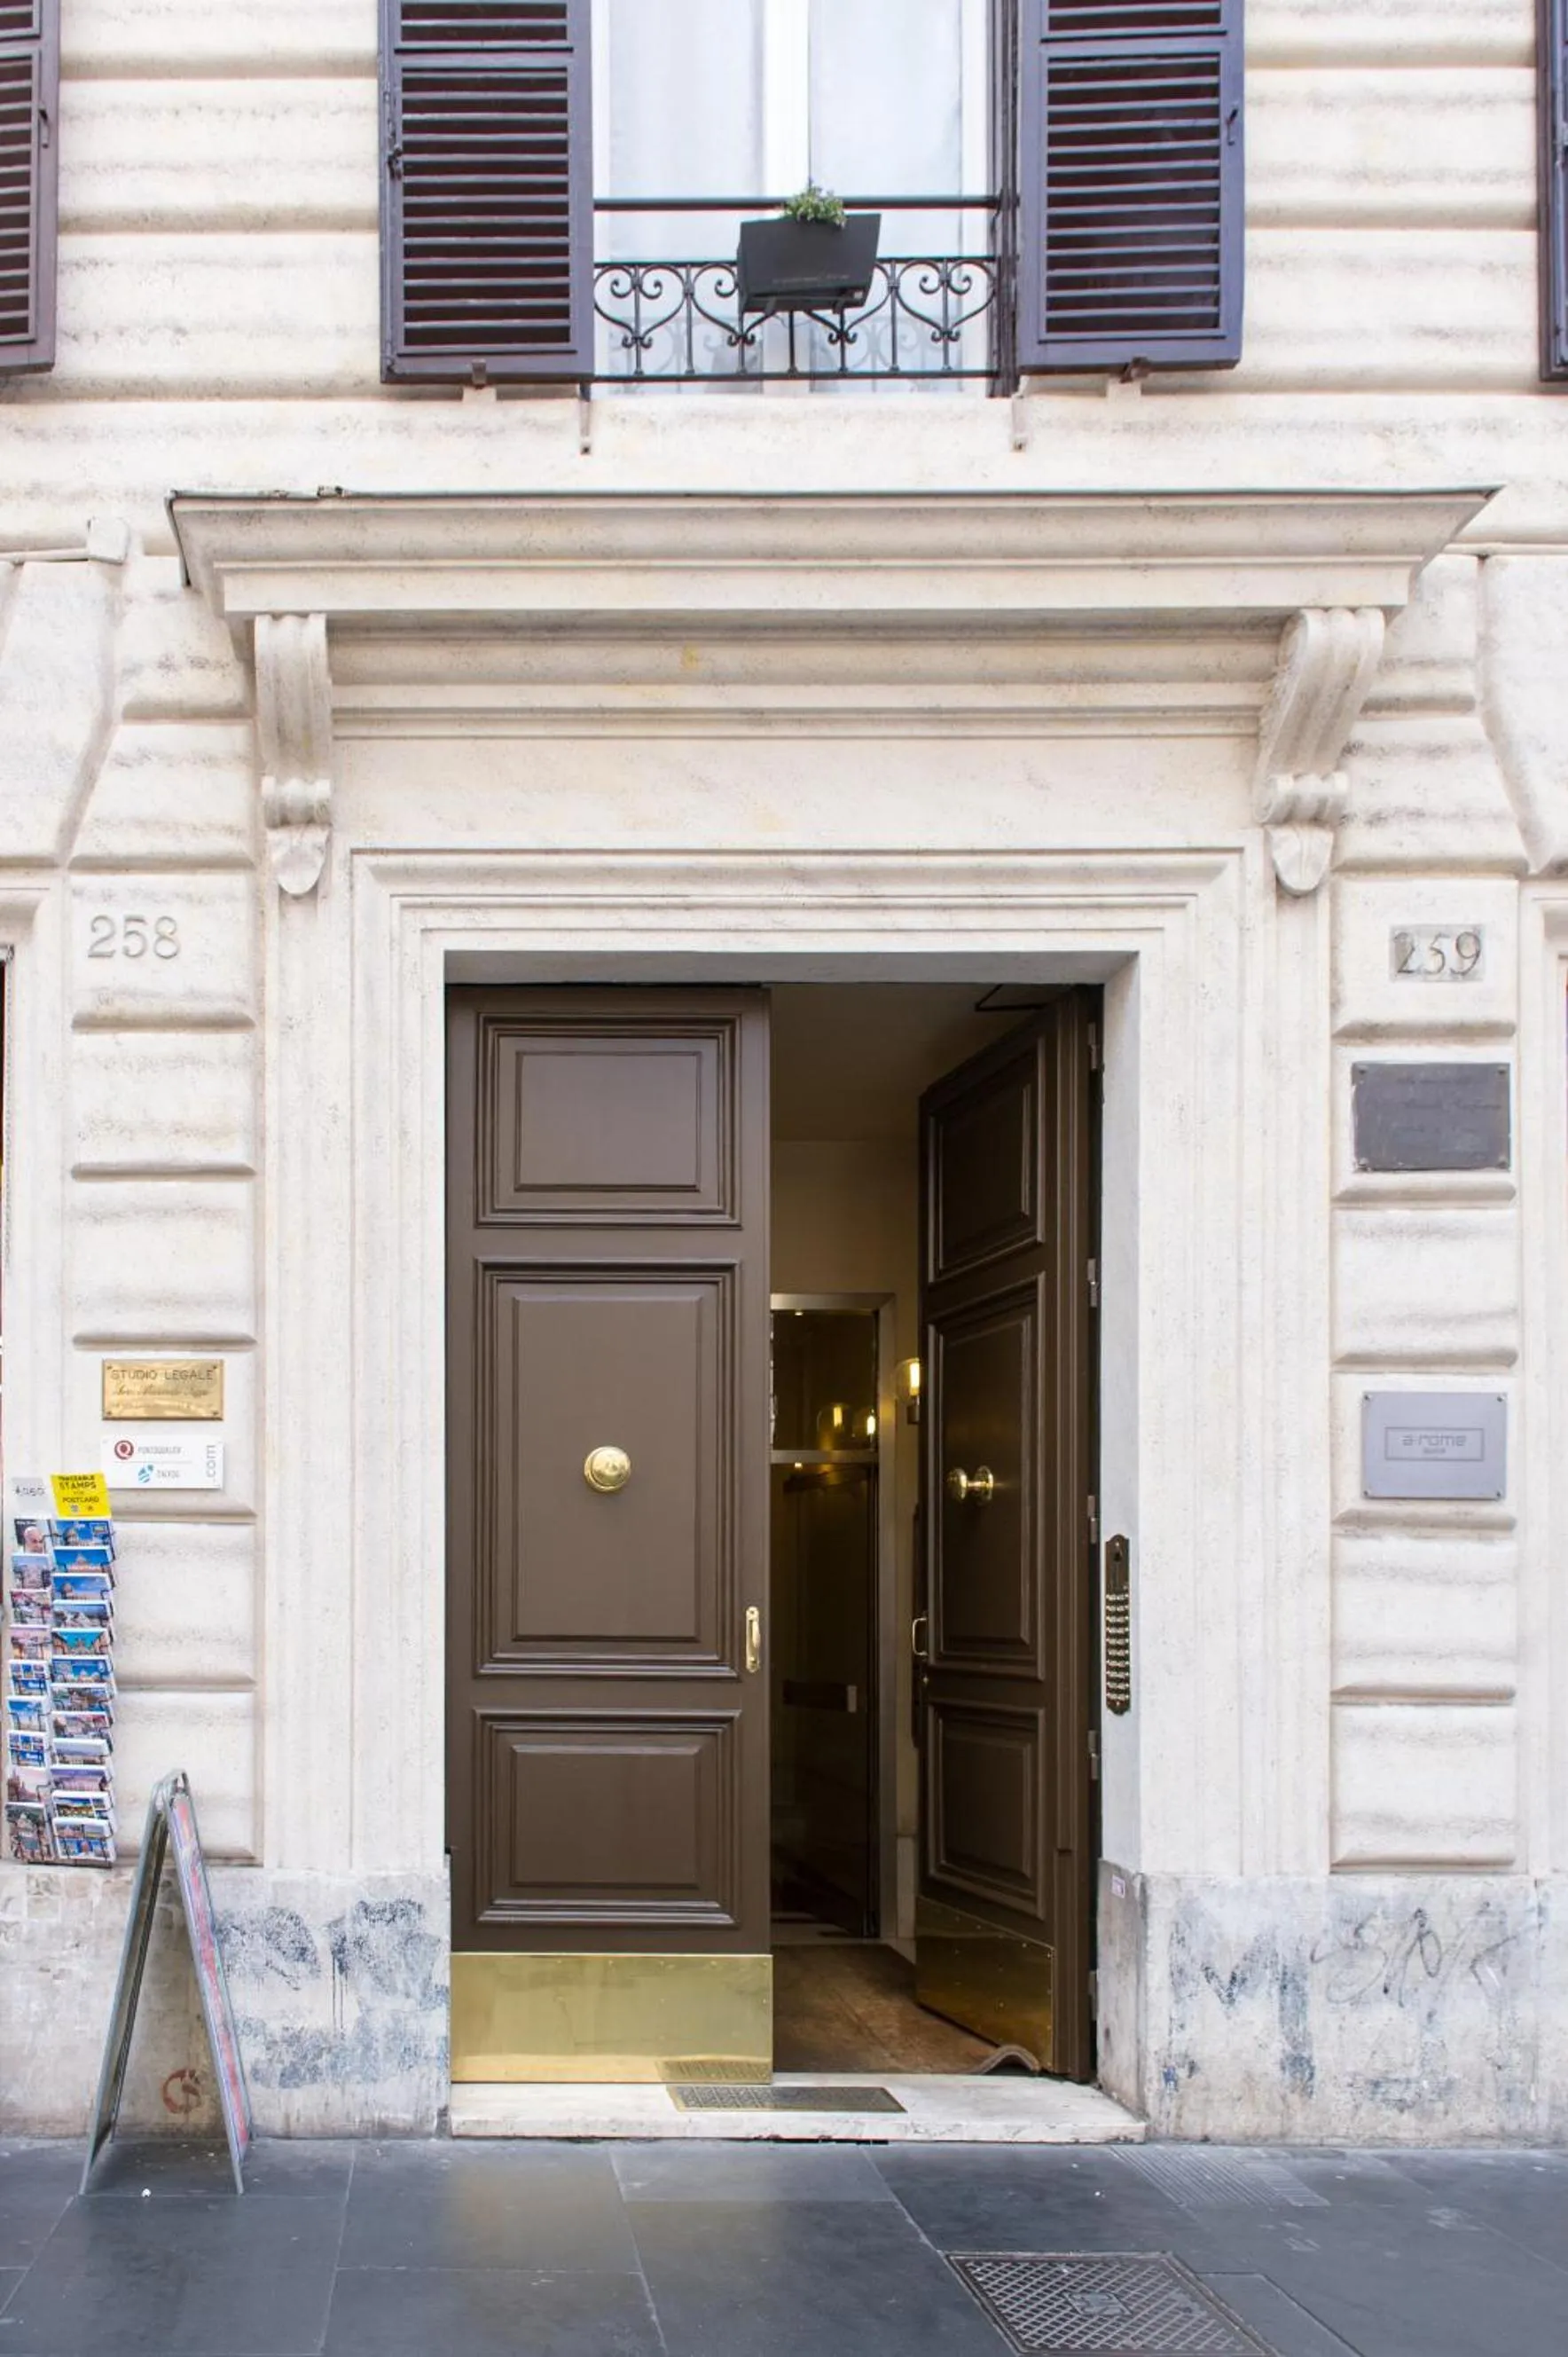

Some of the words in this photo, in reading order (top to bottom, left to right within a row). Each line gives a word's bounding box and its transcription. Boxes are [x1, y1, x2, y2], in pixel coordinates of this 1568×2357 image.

[87, 915, 181, 960] 258
[1393, 931, 1482, 977] 259
[110, 1369, 158, 1380] STUDIO
[164, 1369, 214, 1380] LEGALE
[59, 1481, 97, 1491] STAMPS
